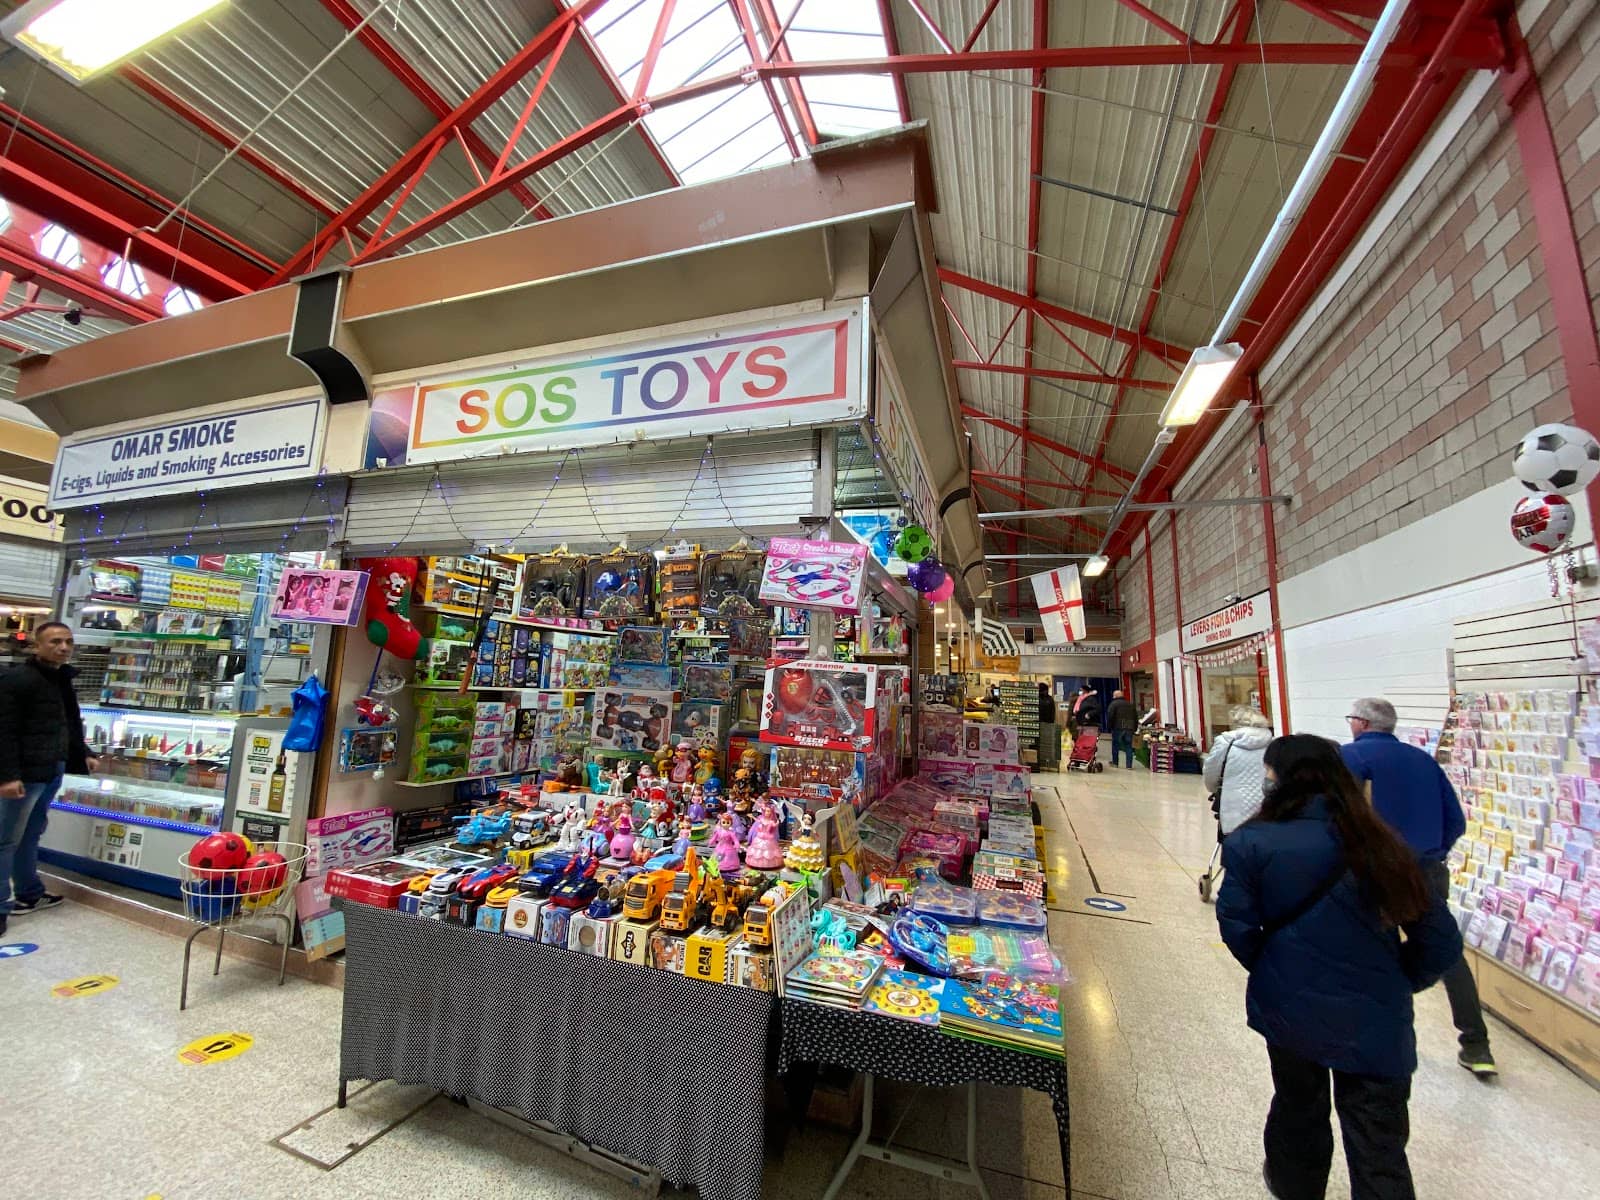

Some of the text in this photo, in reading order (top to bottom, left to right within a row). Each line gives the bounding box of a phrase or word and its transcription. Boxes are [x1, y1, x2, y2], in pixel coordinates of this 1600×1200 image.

[456, 345, 788, 434] SOS TOYS
[111, 419, 237, 462] OMAR SMOKE
[61, 442, 305, 493] E-cigs, Liquids and Smoking Accessories
[1190, 621, 1210, 637] LEVERS
[625, 933, 633, 957] Truck
[698, 946, 713, 976] CAR
